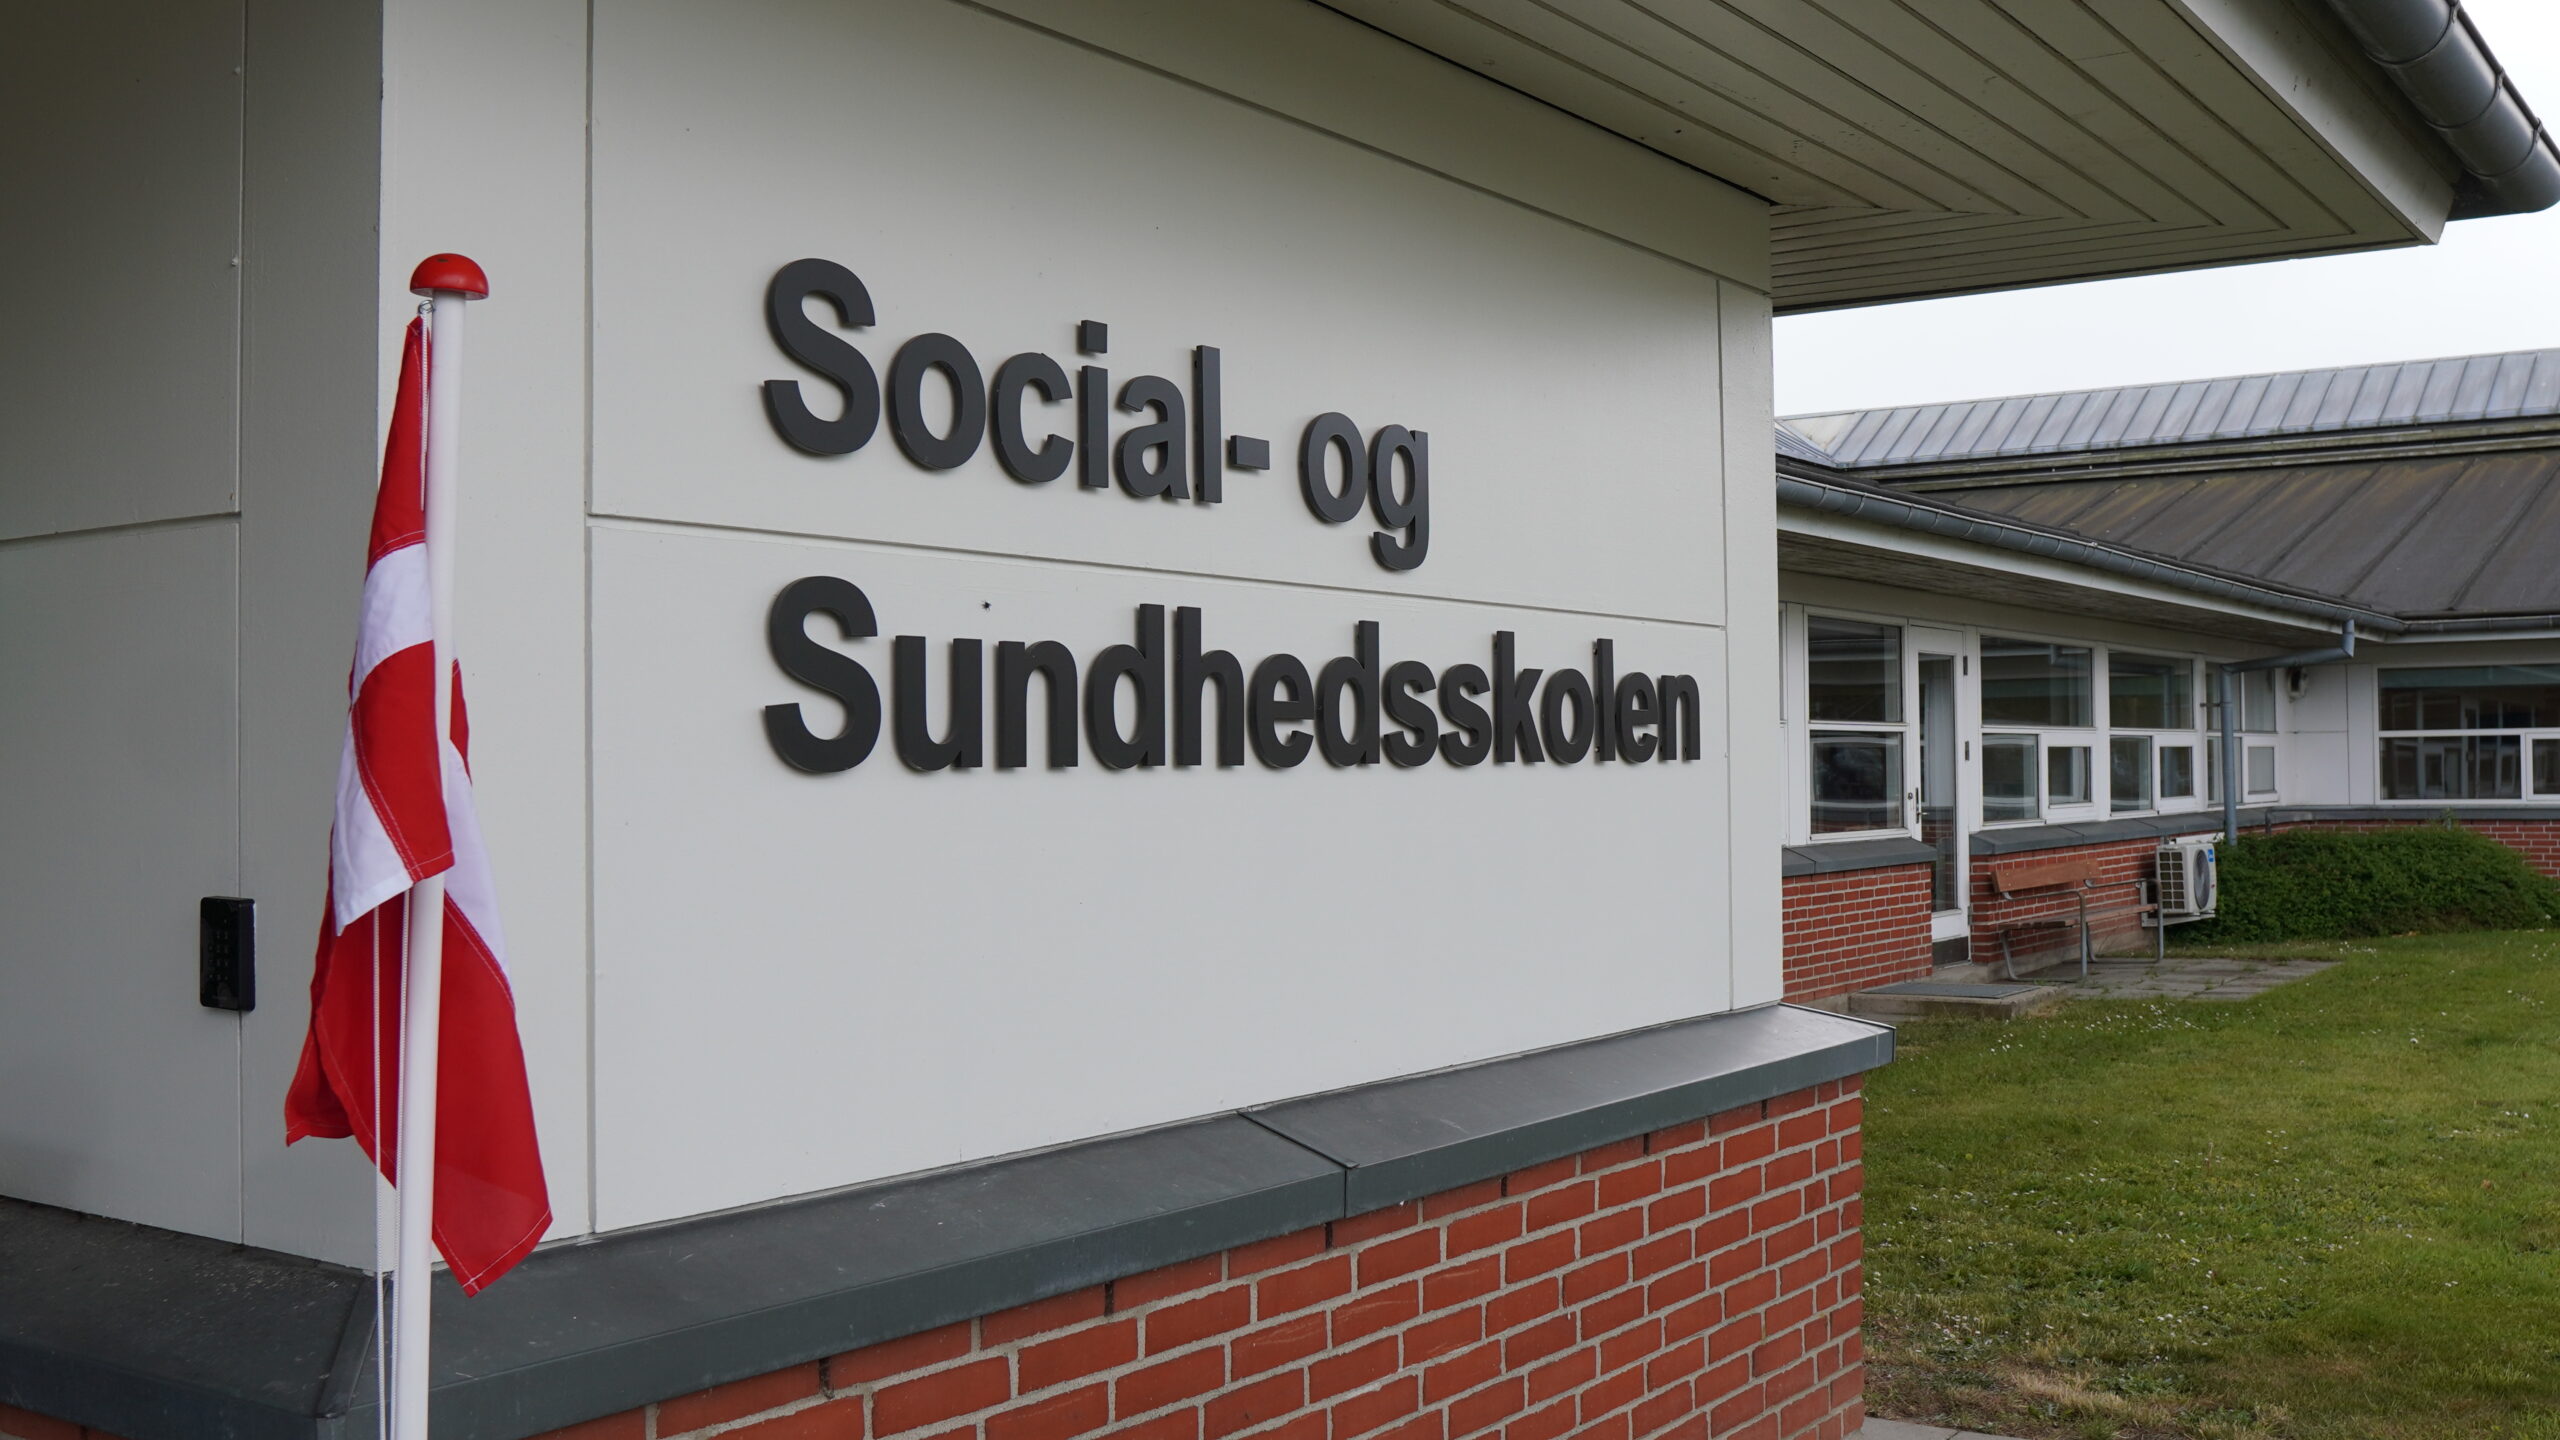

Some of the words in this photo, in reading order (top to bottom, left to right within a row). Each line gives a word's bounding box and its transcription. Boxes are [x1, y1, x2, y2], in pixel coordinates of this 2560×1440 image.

[763, 258, 1269, 505] Social-
[1299, 411, 1429, 571] og
[764, 575, 1700, 774] Sundhedsskolen
